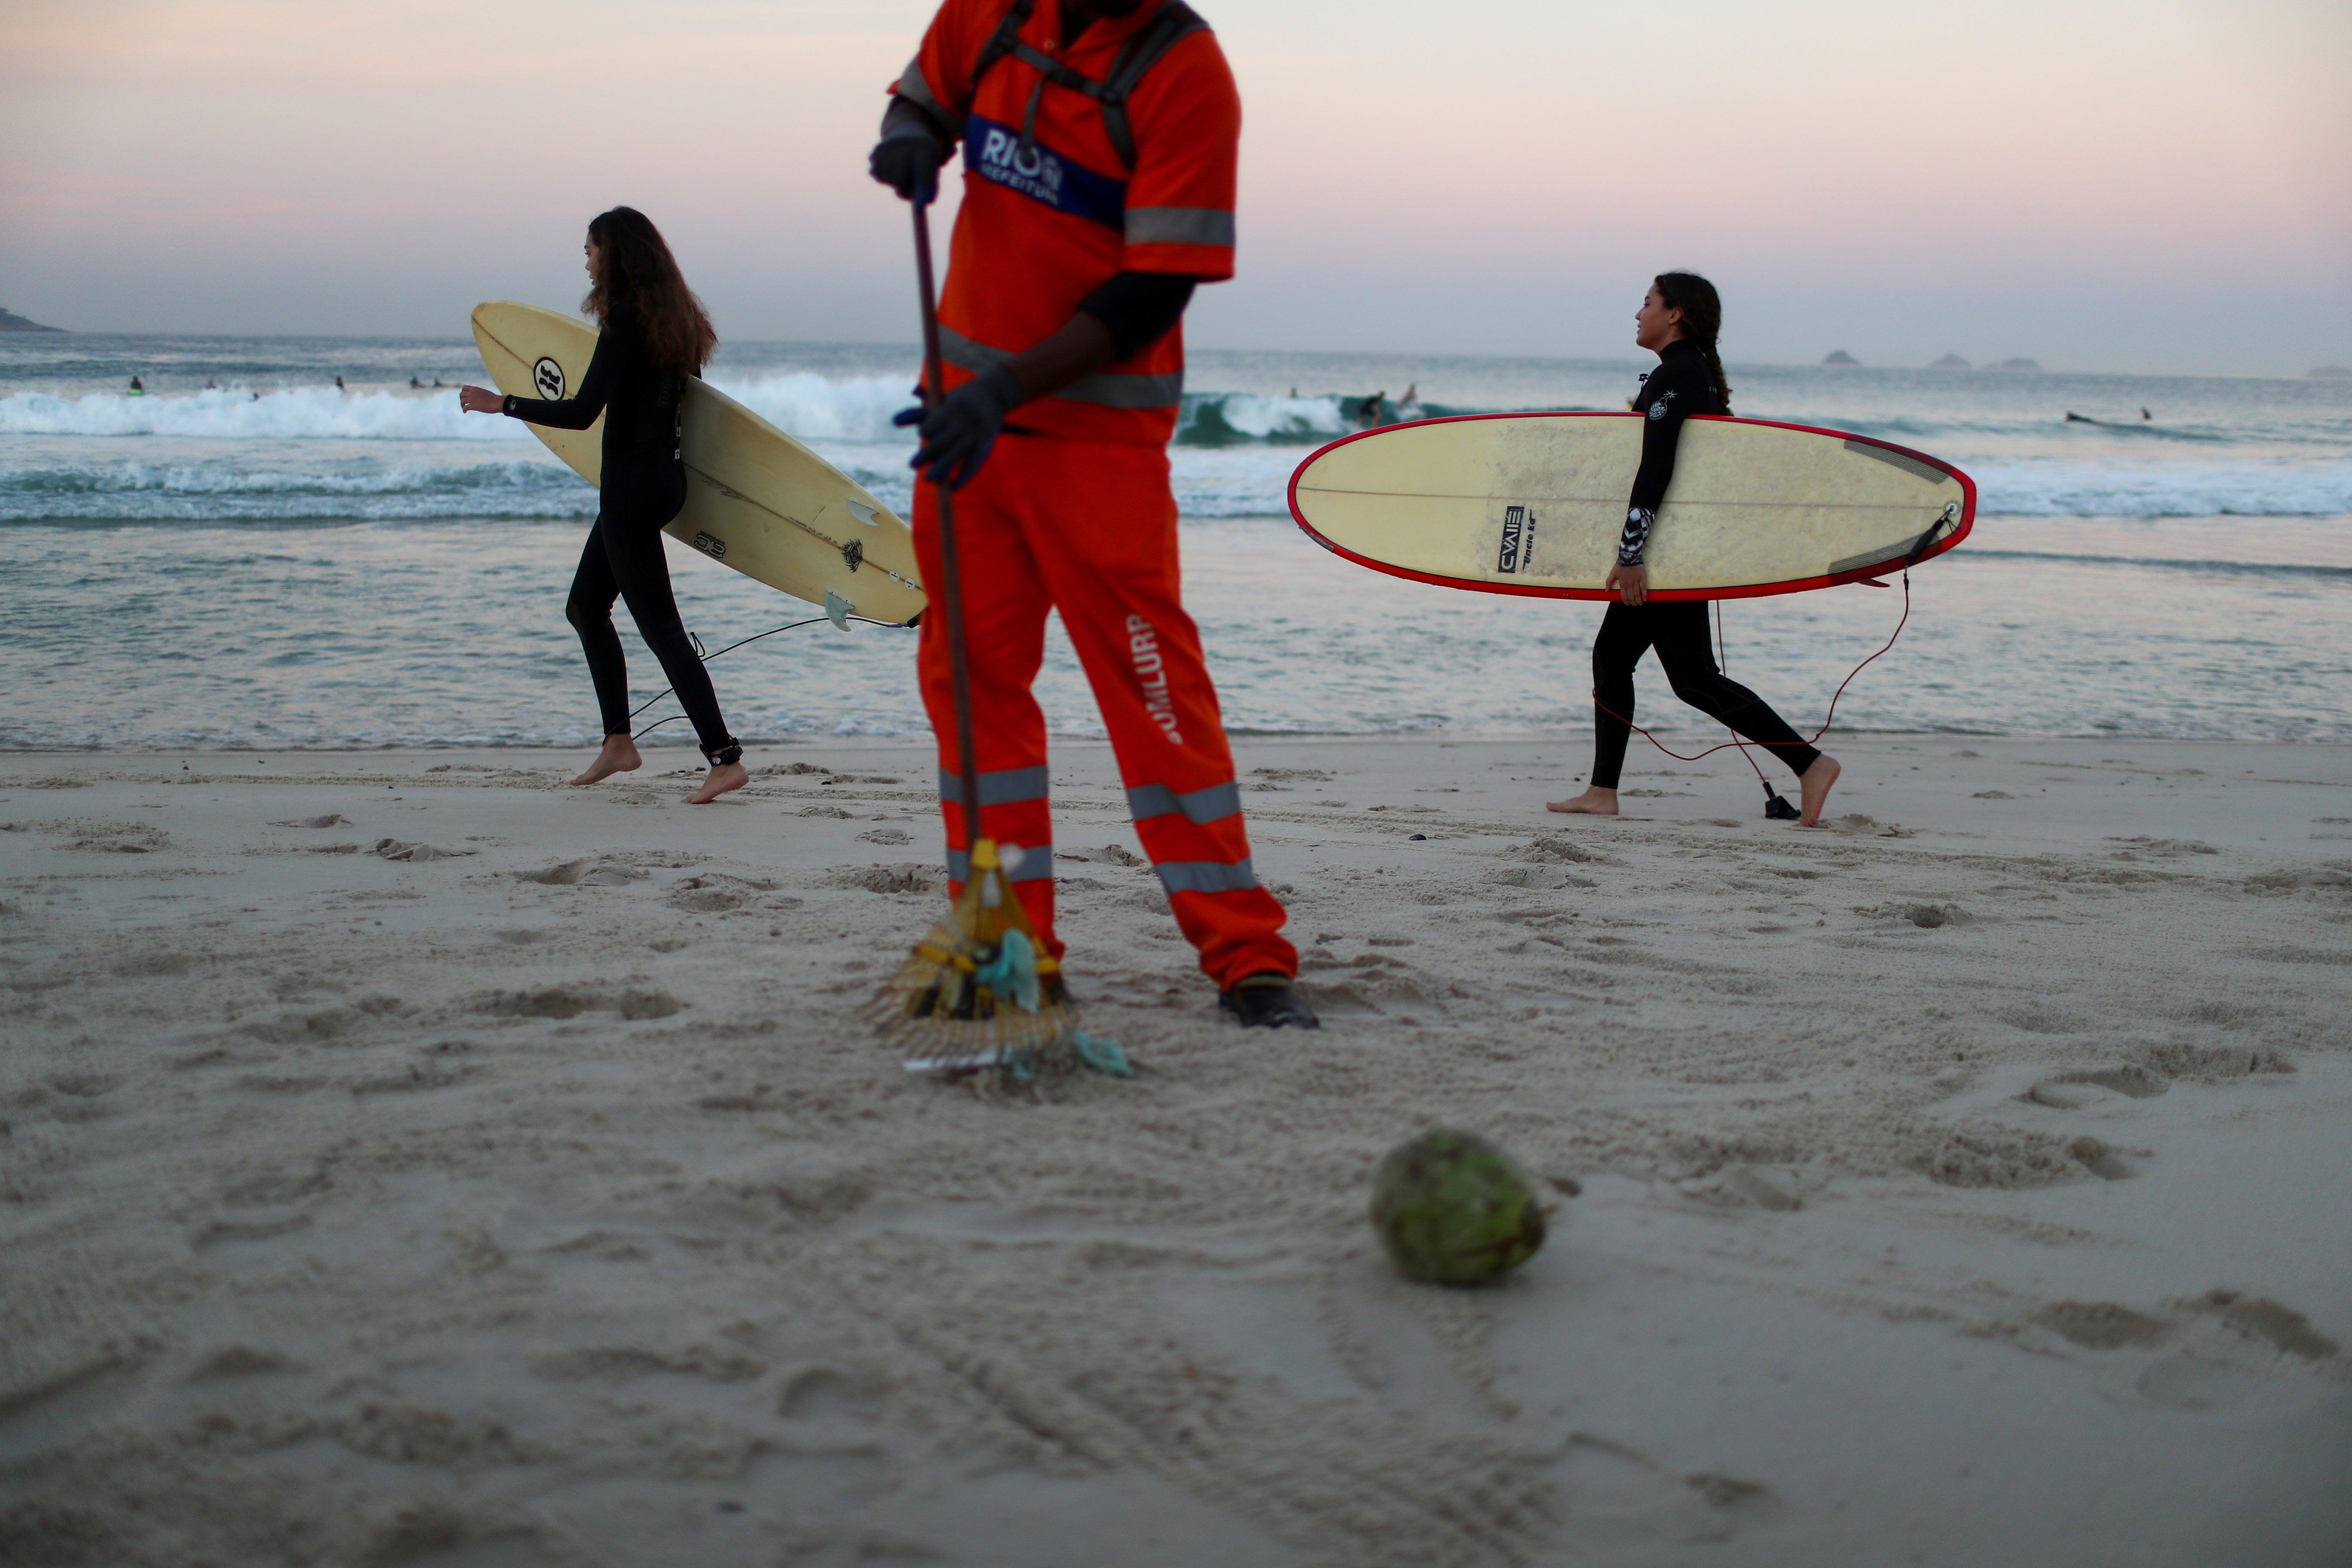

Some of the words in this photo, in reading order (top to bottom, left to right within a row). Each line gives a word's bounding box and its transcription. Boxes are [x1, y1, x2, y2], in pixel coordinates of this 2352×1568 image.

[981, 129, 1041, 178] RIO
[1528, 511, 1536, 532] Ed
[1523, 534, 1534, 570] Uncle
